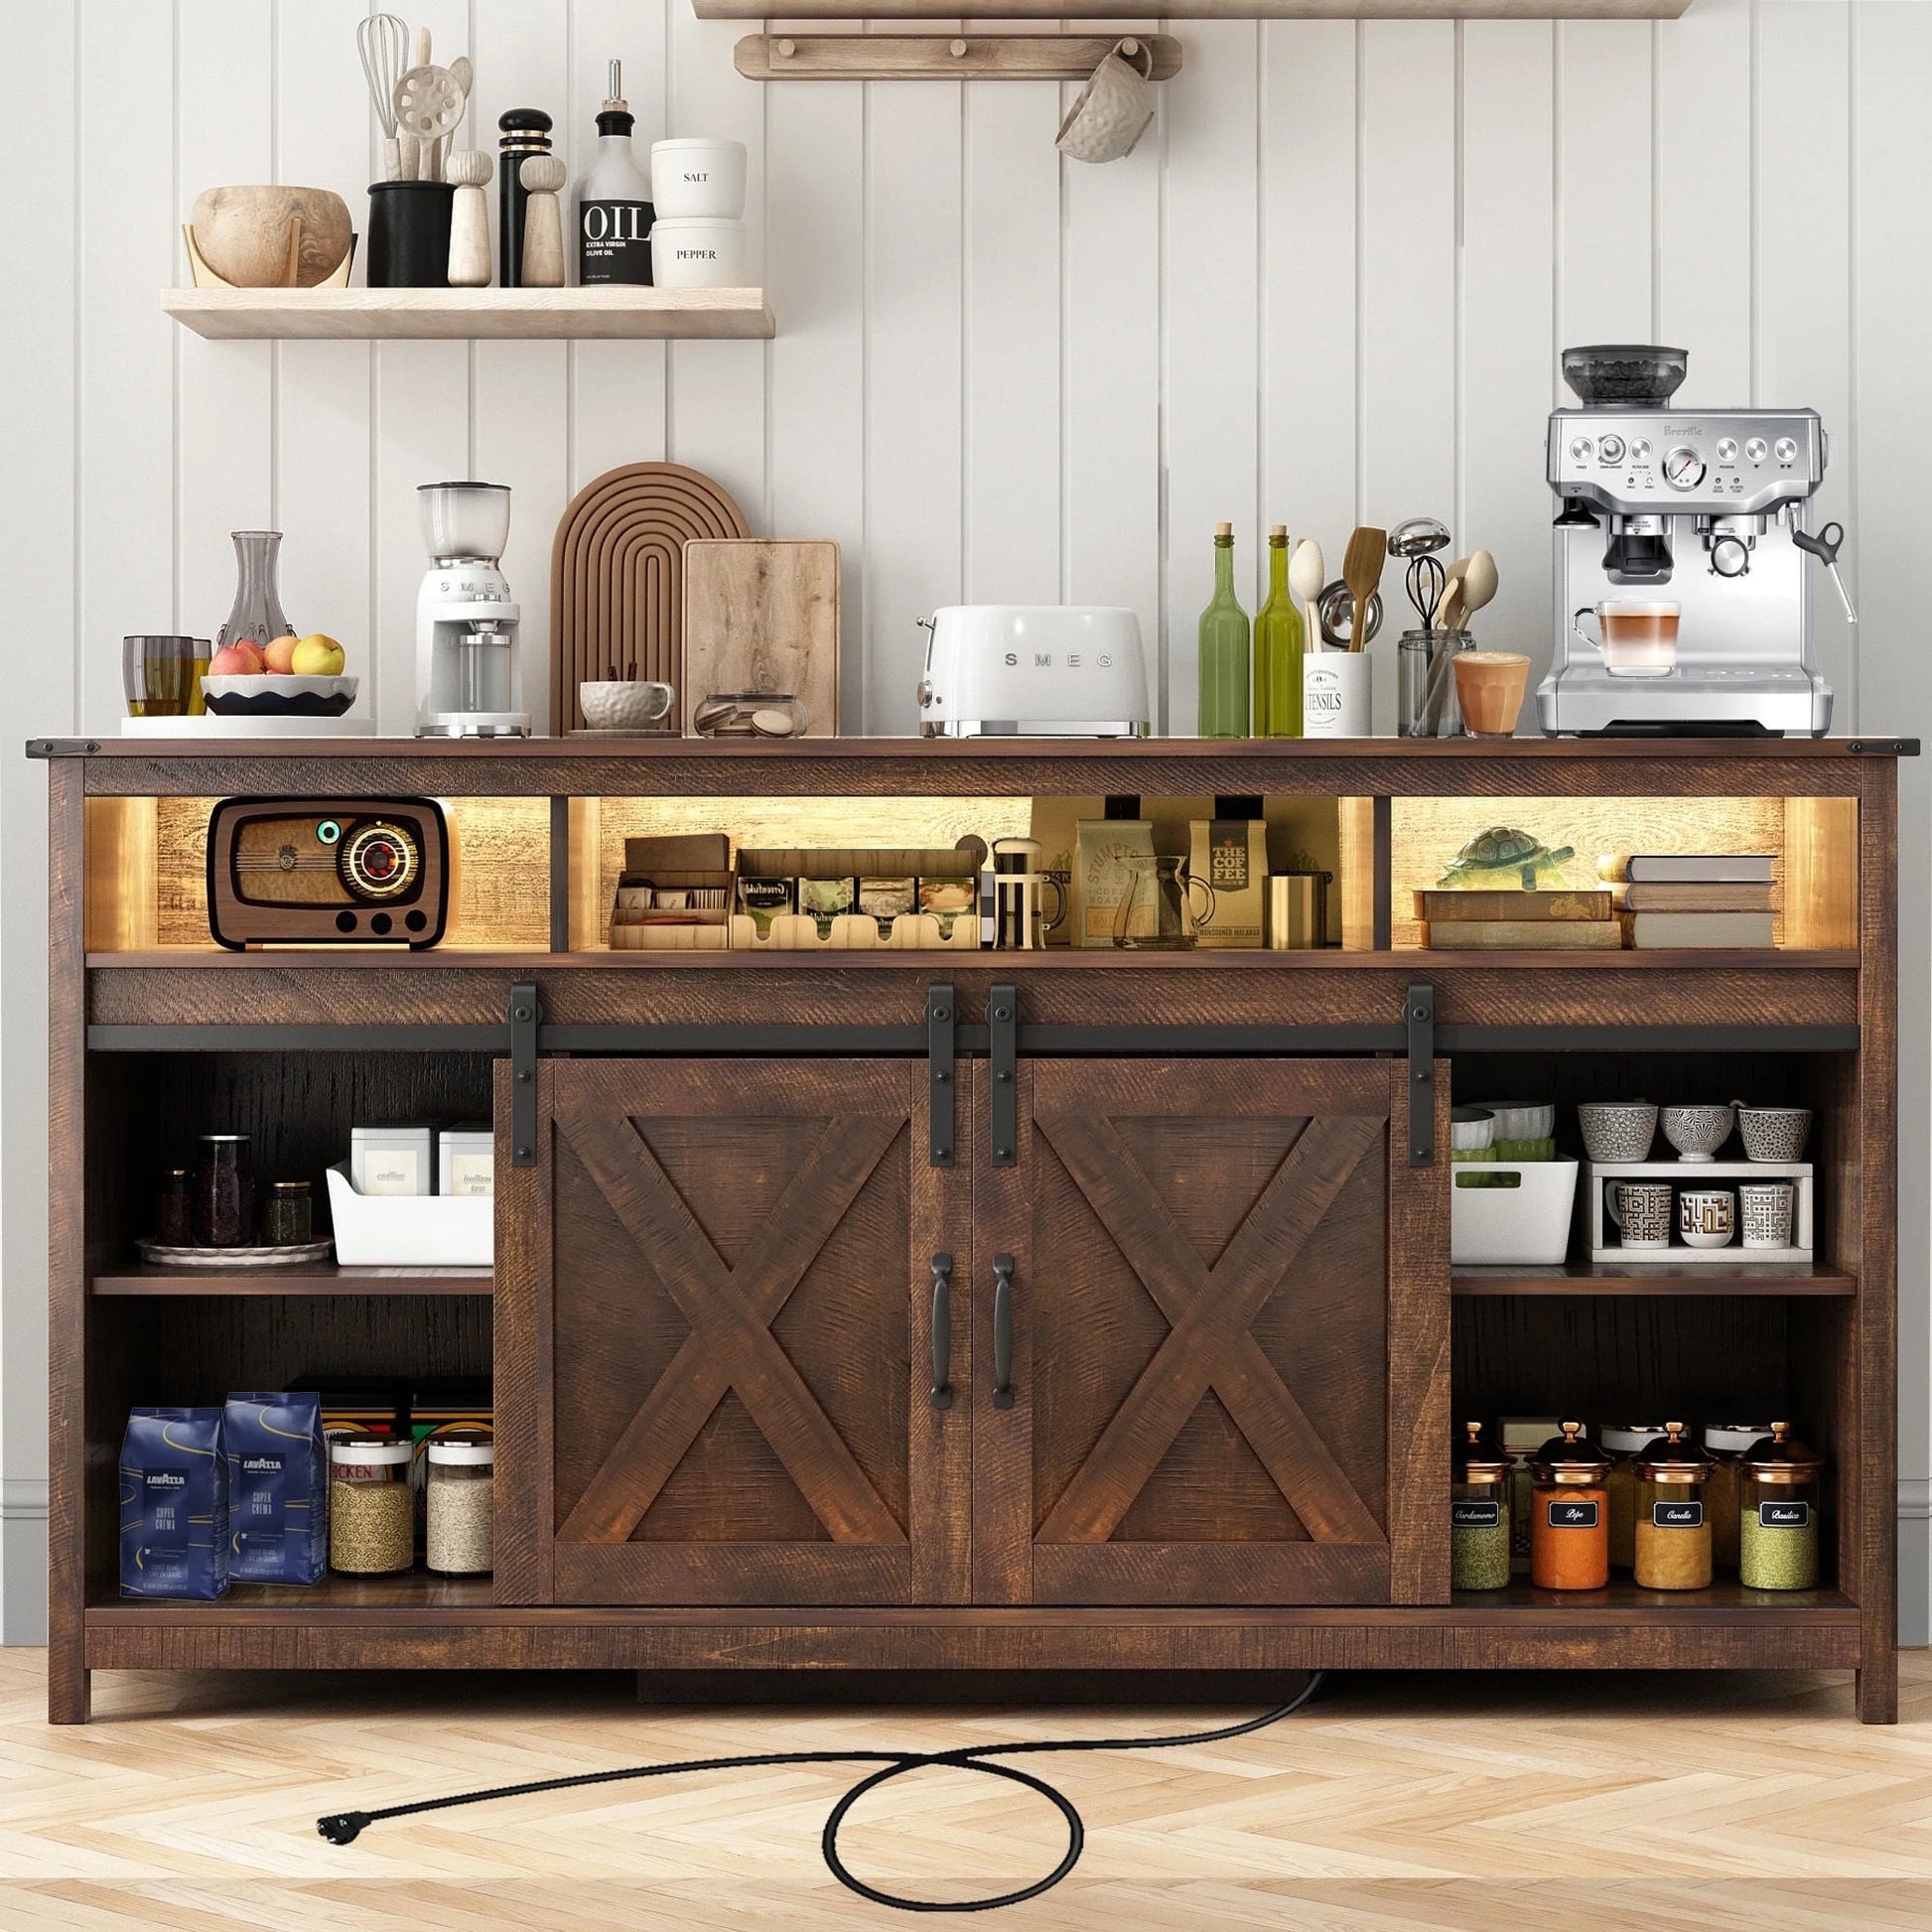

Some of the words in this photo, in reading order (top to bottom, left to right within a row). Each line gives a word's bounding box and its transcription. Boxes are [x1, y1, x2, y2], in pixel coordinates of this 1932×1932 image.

[683, 173, 709, 183] SALT
[584, 206, 651, 241] OIL
[676, 249, 717, 260] PEPPER
[1664, 425, 1704, 437] Breville
[440, 581, 510, 593] SMEG
[1005, 652, 1113, 667] SMEG
[1212, 847, 1246, 857] THE
[1213, 857, 1246, 868] COF
[1213, 868, 1246, 880] FEE
[243, 1457, 282, 1469] LAVAZZA
[146, 1473, 186, 1485] LAVAZZA
[252, 1492, 272, 1503] SUPER
[156, 1507, 175, 1518] SUPER
[251, 1503, 273, 1515] CREMA
[155, 1519, 176, 1530] CREMA
